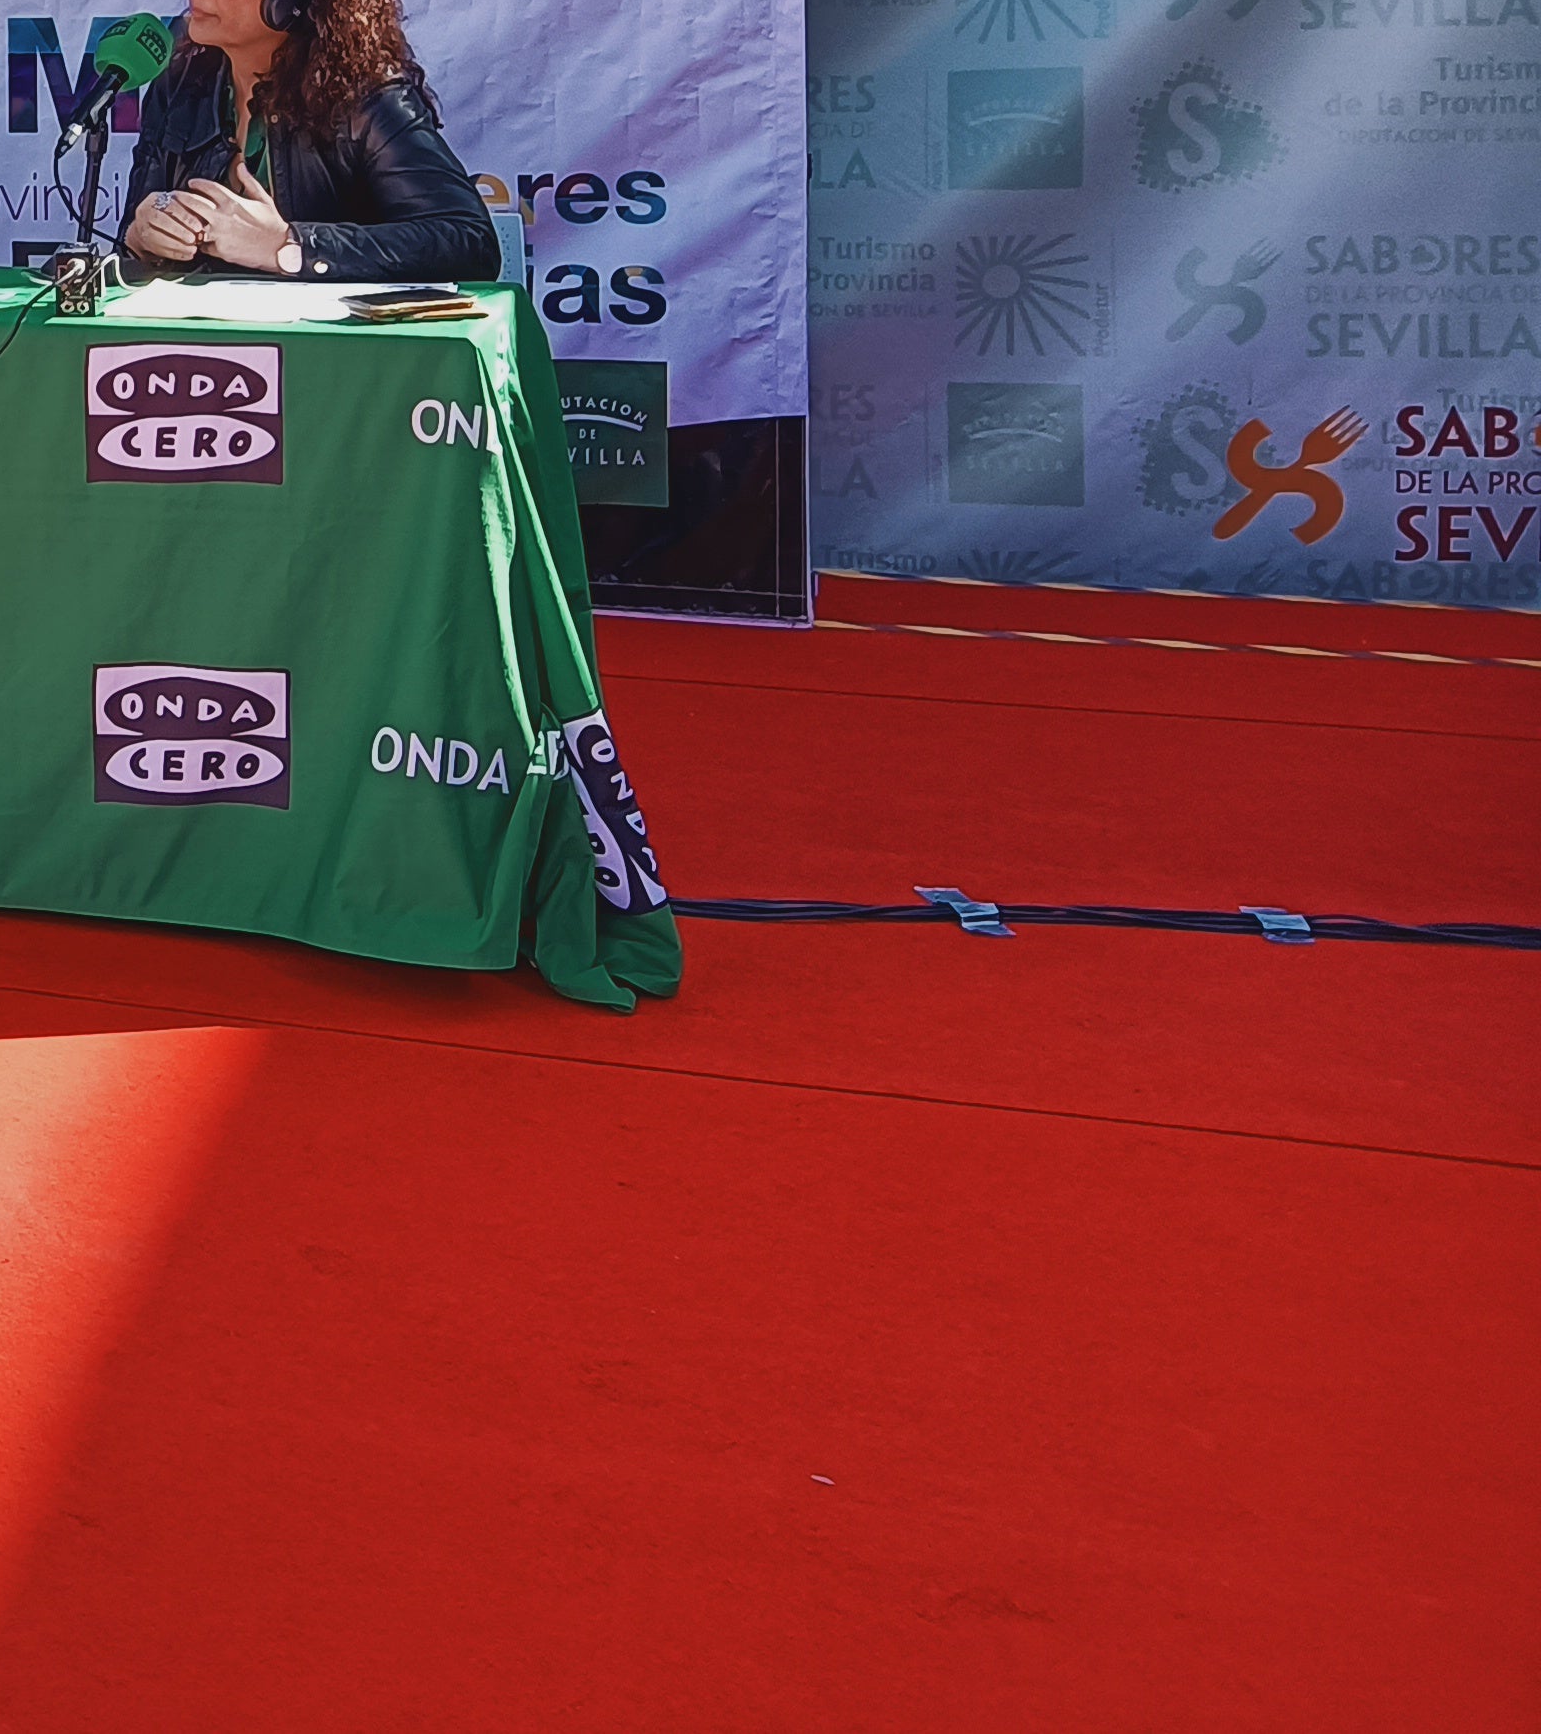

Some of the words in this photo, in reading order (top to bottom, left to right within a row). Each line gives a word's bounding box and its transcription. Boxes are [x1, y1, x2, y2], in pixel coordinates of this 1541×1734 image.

[477, 169, 668, 225] eres
[112, 372, 250, 400] ONDA
[560, 395, 649, 425] UTACION
[120, 425, 253, 458] CERO
[579, 428, 596, 440] DE
[566, 448, 646, 466] VILLA
[1395, 469, 1433, 494] DE
[1443, 470, 1479, 495] LA
[120, 692, 258, 723] ONDA
[129, 747, 260, 782] CERO
[371, 726, 510, 794] ONDA
